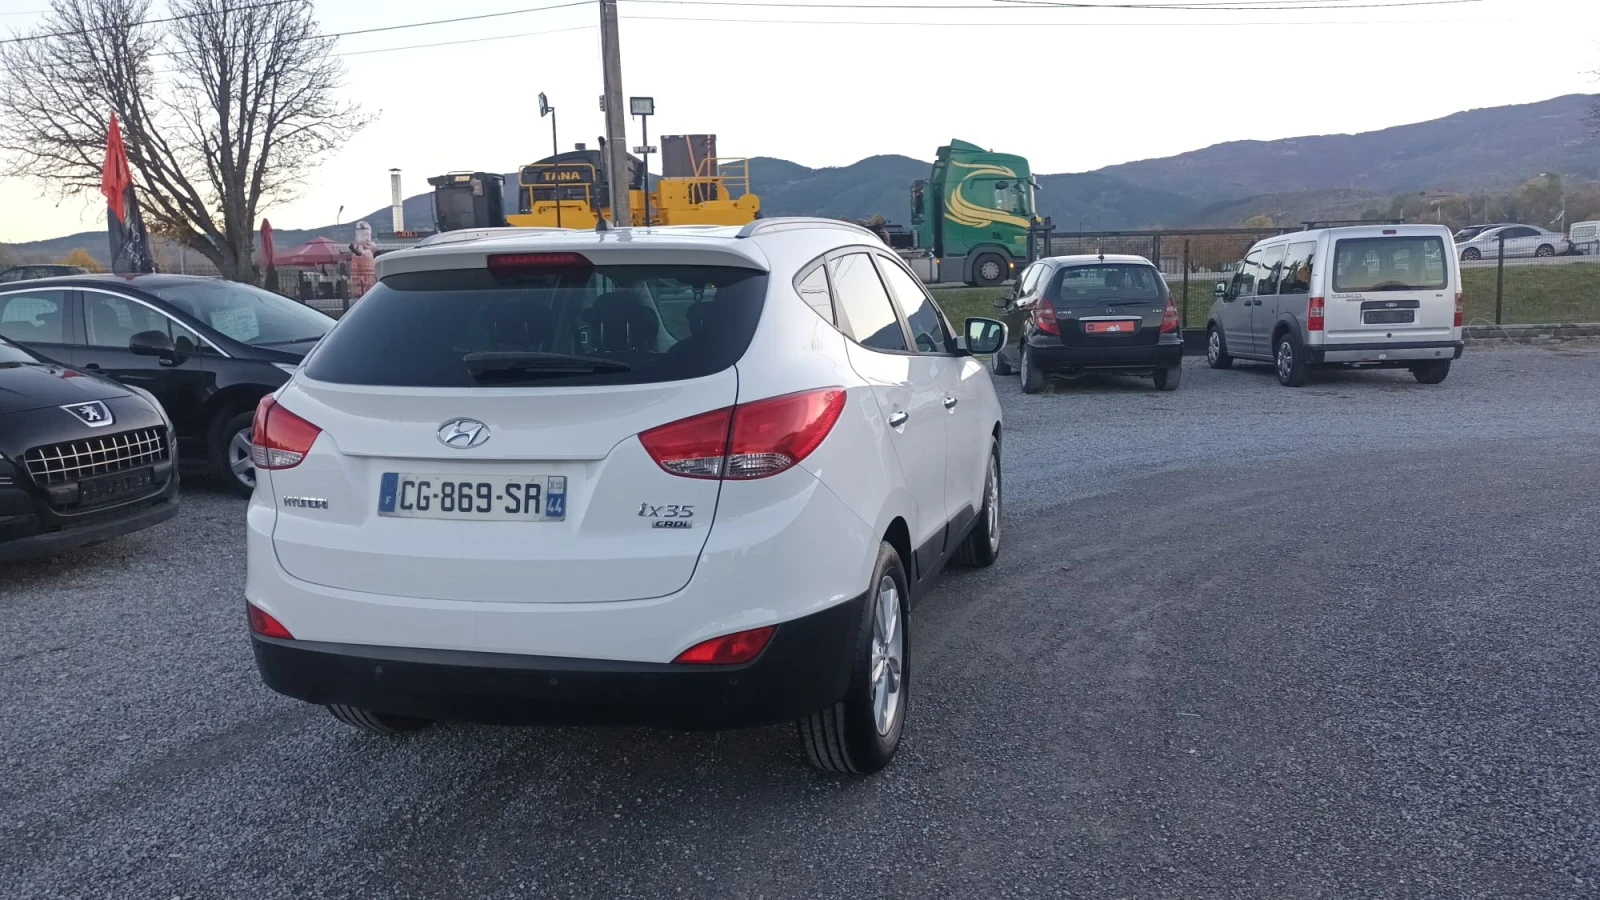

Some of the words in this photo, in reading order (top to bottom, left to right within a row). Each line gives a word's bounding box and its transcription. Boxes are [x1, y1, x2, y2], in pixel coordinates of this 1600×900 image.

[543, 171, 581, 181] TANA
[385, 496, 392, 505] F
[400, 480, 541, 514] CG-869-SR
[547, 498, 563, 513] 44
